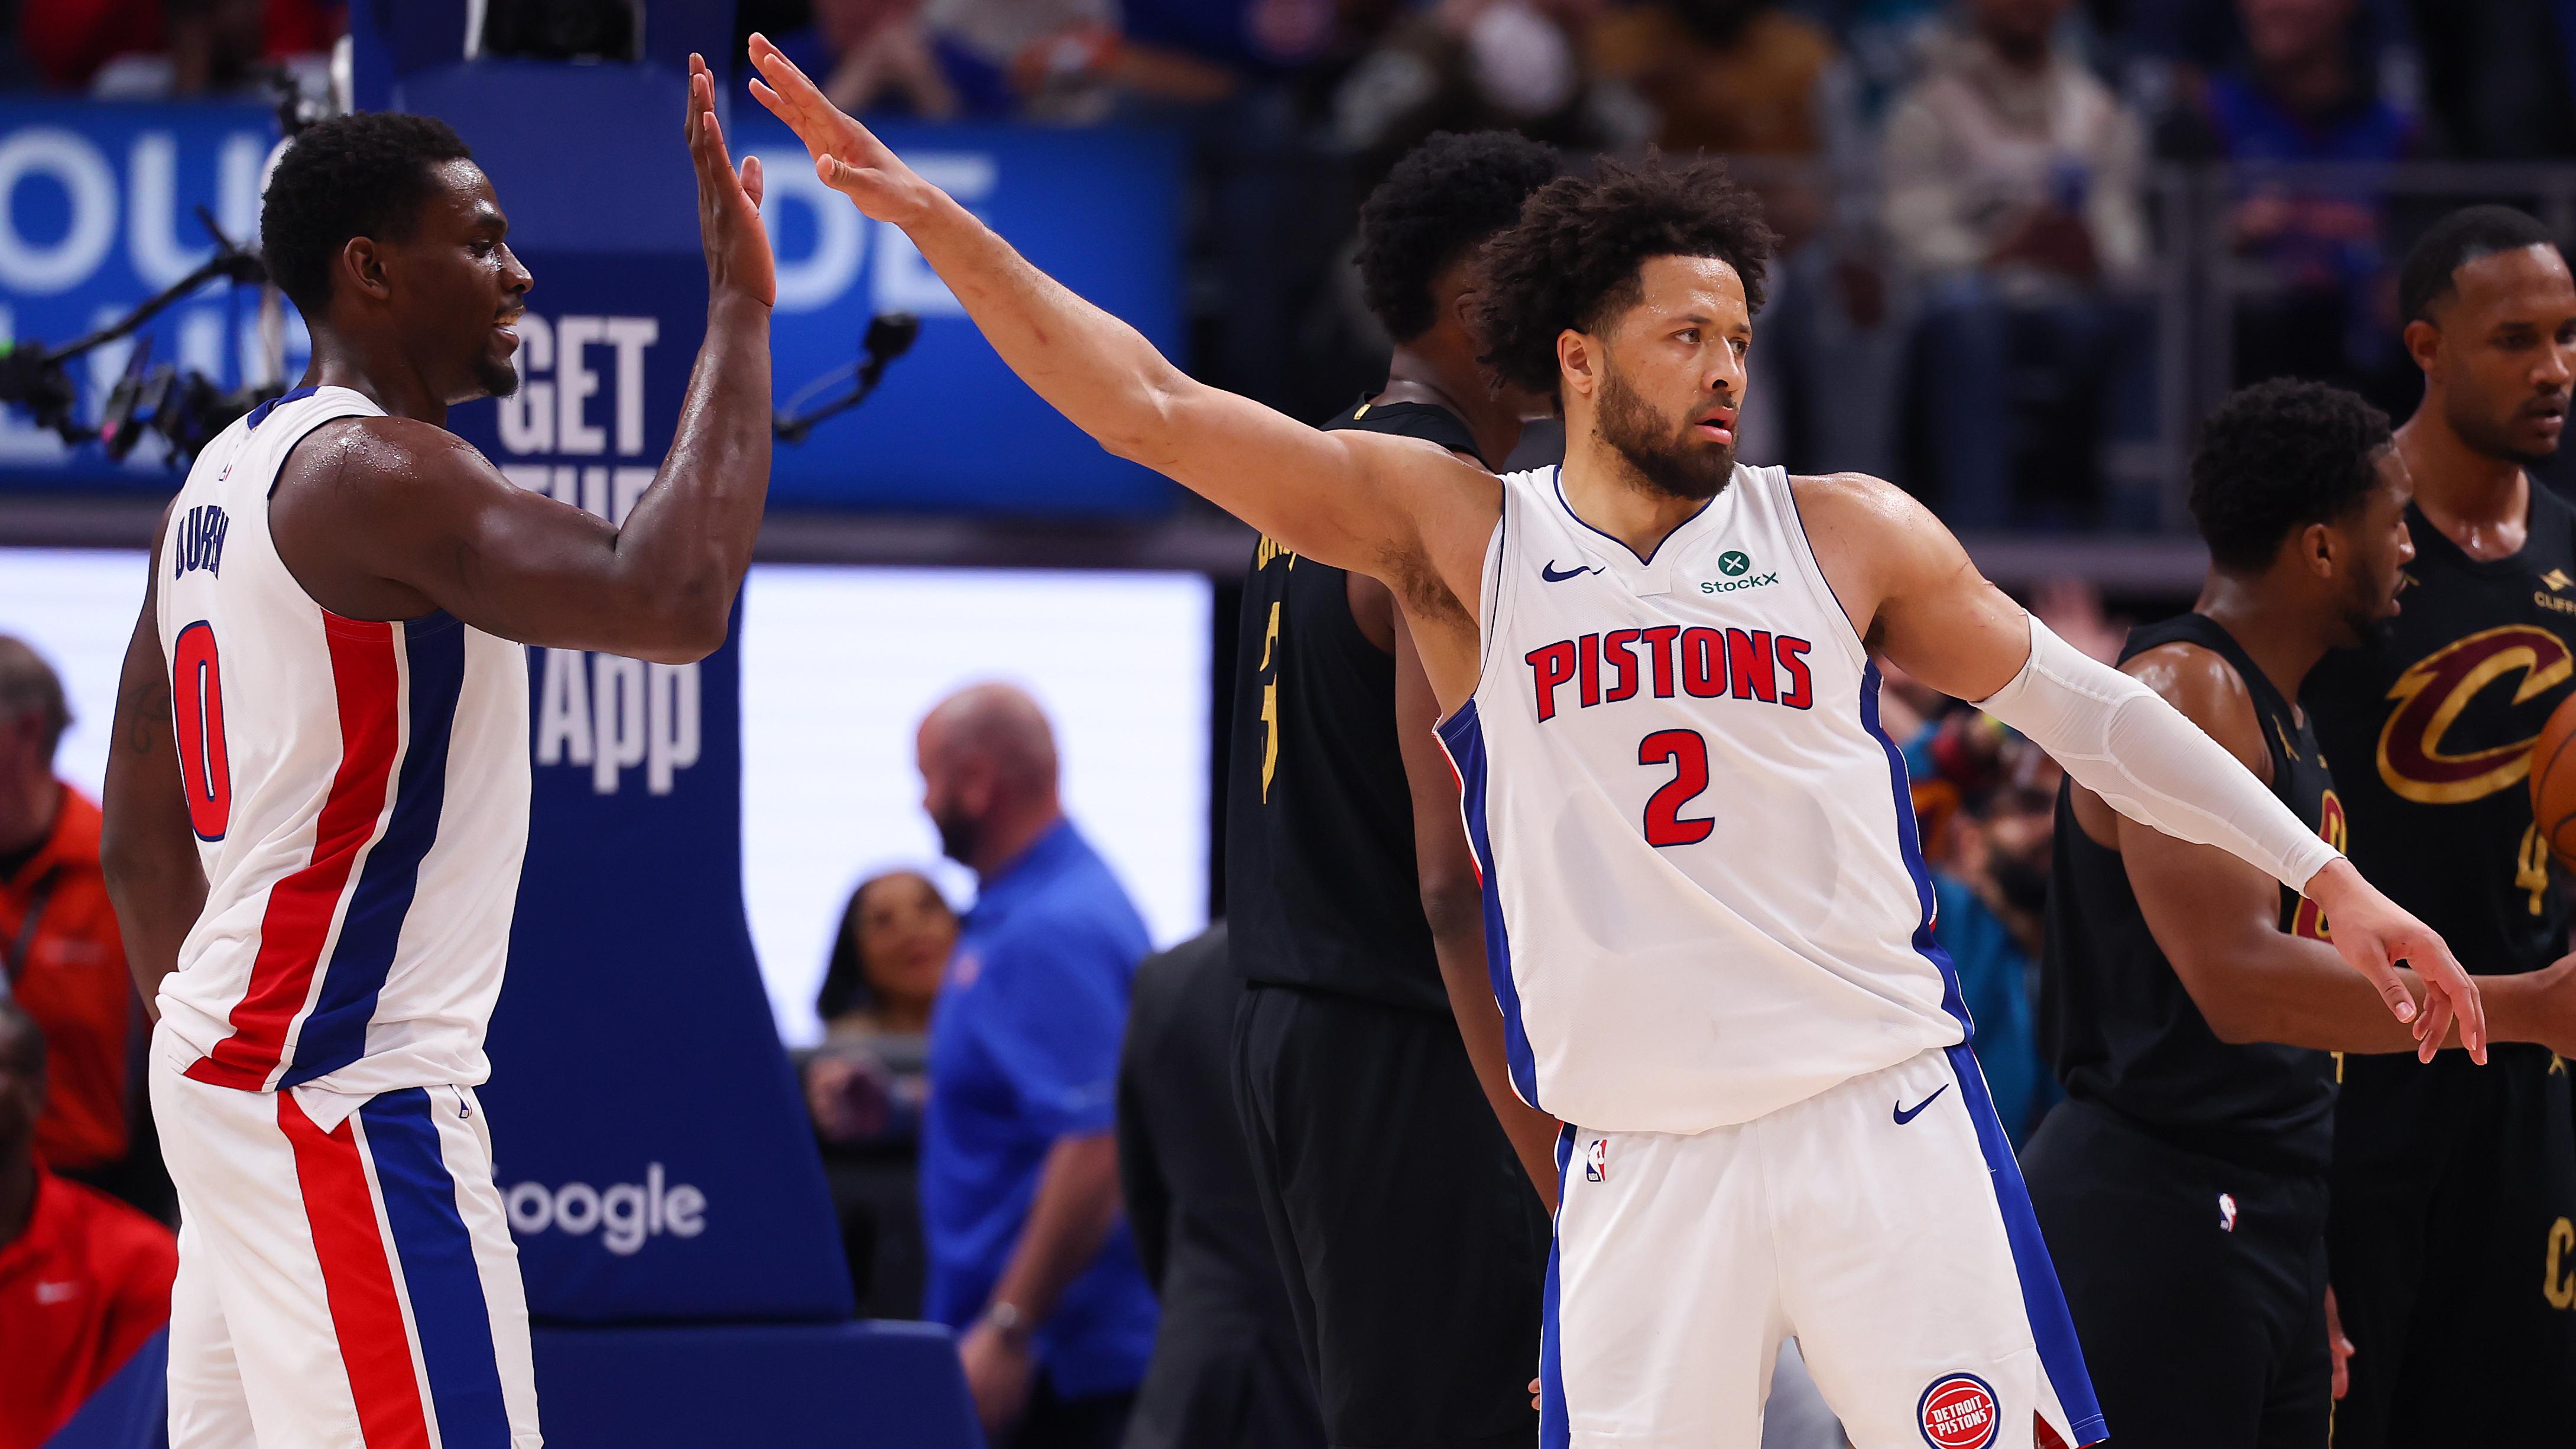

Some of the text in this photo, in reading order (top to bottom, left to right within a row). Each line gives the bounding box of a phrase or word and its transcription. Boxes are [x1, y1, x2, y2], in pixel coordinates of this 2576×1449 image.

[497, 313, 660, 456] GET
[1701, 572, 1779, 594] StockX
[2533, 591, 2576, 616] CLIFF
[536, 648, 703, 796] App
[1524, 624, 1813, 724] PISTONS
[173, 619, 232, 842] 0
[1638, 728, 1715, 848] 2
[492, 1161, 708, 1257] oogle
[1931, 1395, 1983, 1424] DETROIT
[1935, 1408, 1988, 1437] PISTONS
